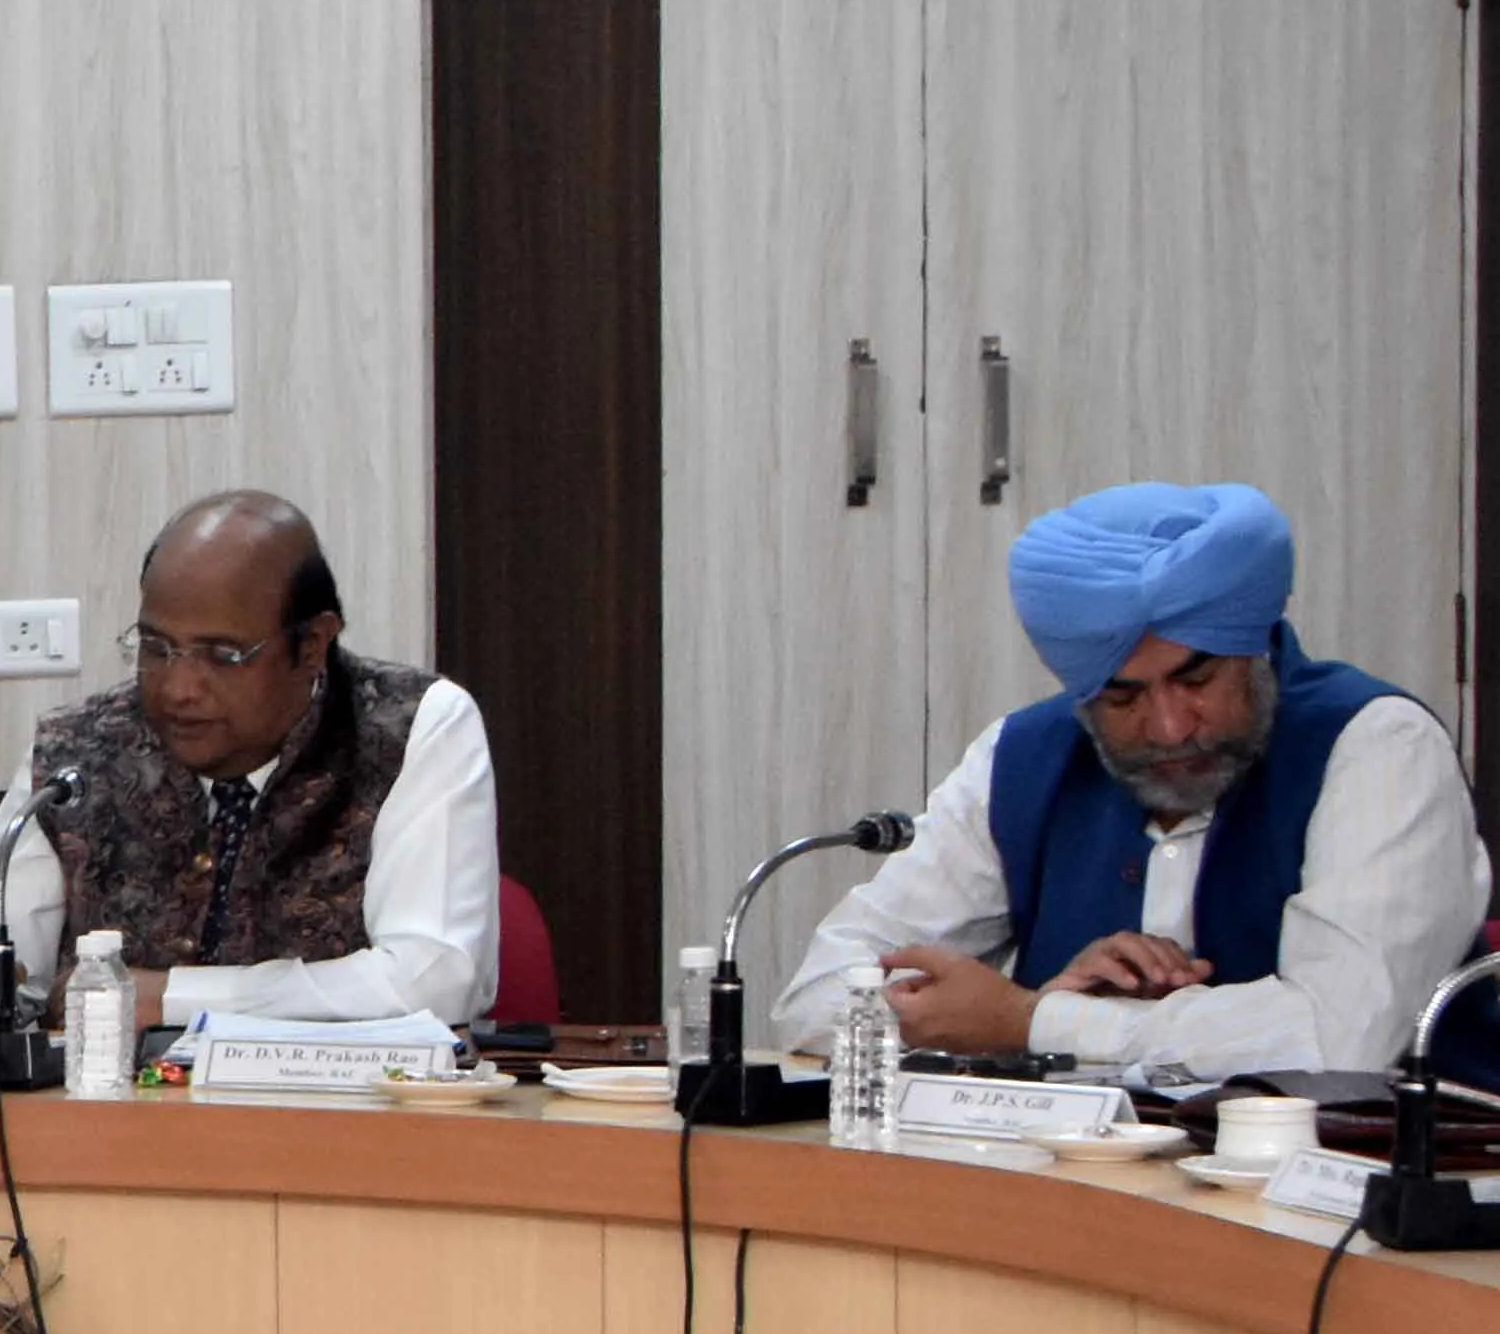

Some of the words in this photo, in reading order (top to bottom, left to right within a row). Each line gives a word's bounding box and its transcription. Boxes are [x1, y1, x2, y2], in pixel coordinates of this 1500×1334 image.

[224, 1046, 251, 1059] Dr.
[315, 1050, 380, 1064] Prakash
[387, 1051, 419, 1064] Rao
[952, 1090, 974, 1105] Dr.
